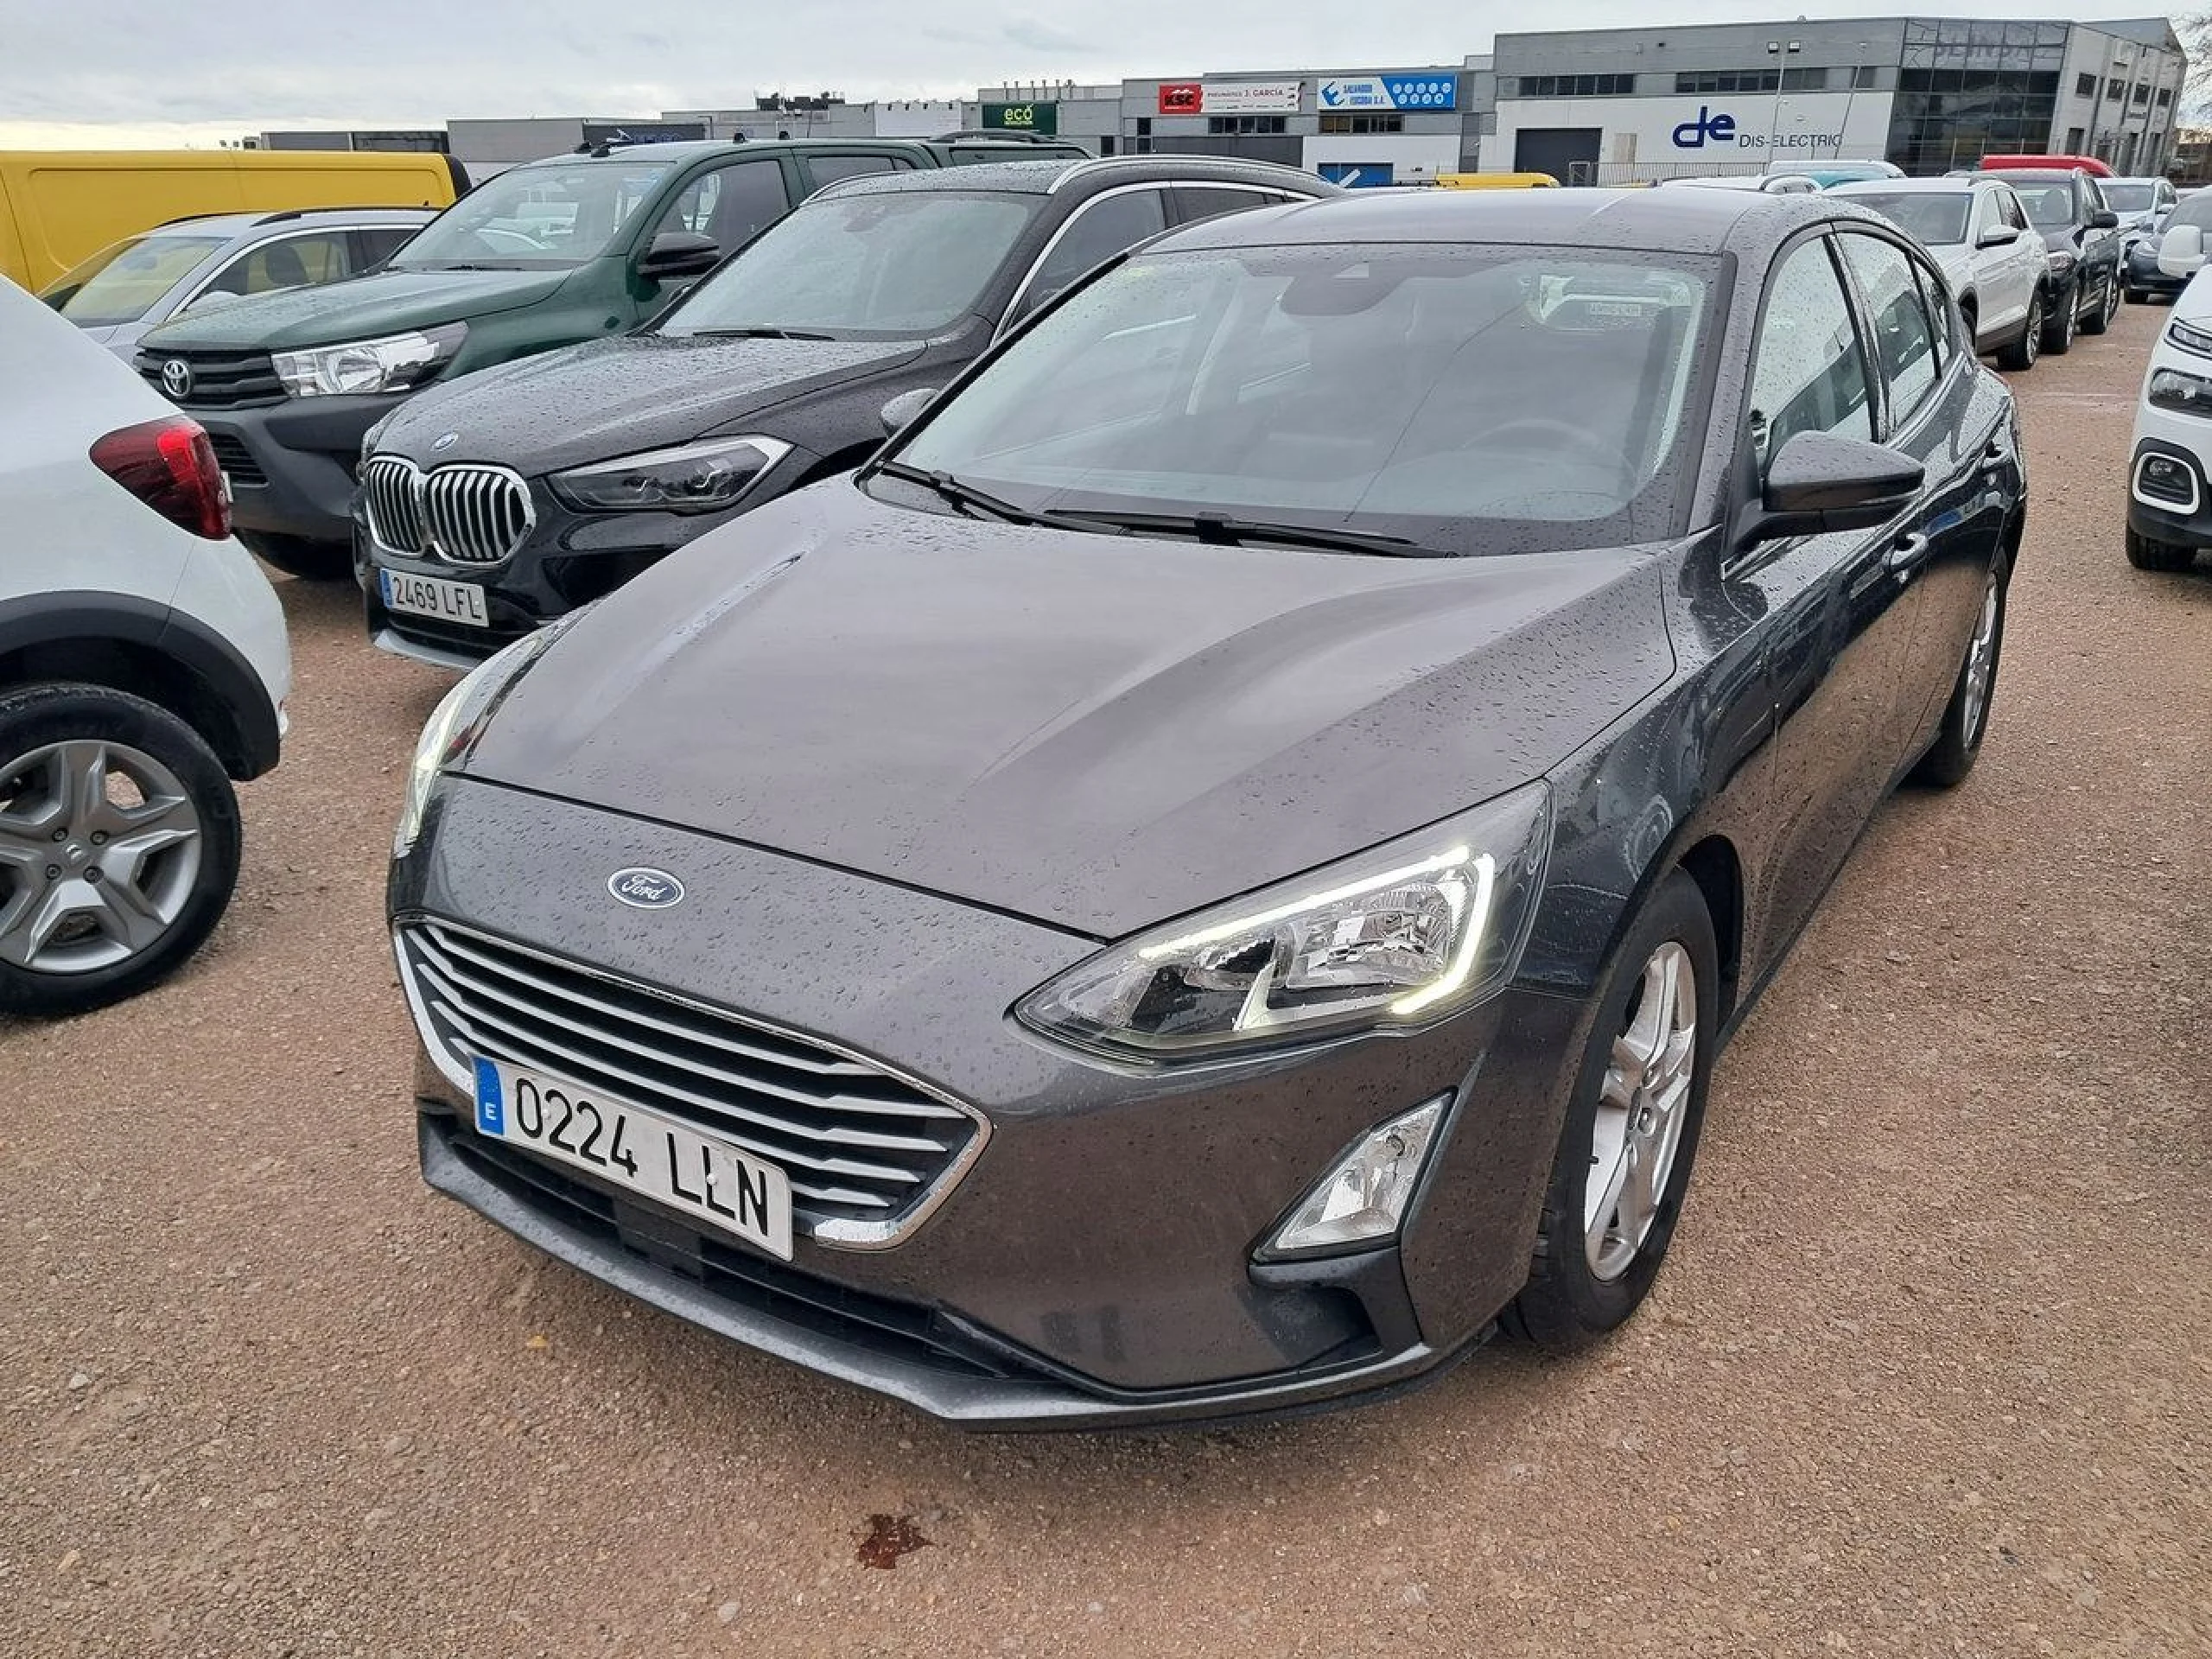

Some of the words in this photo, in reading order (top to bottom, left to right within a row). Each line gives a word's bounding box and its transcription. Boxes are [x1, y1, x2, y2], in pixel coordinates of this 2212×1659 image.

[1739, 134, 1844, 148] DIS-ELECTRIC
[393, 576, 437, 610] 2469
[442, 586, 482, 619] LFL
[621, 874, 668, 900] Ford
[485, 1102, 497, 1121] E
[516, 1077, 639, 1178] 0224
[666, 1132, 769, 1236] LLN
